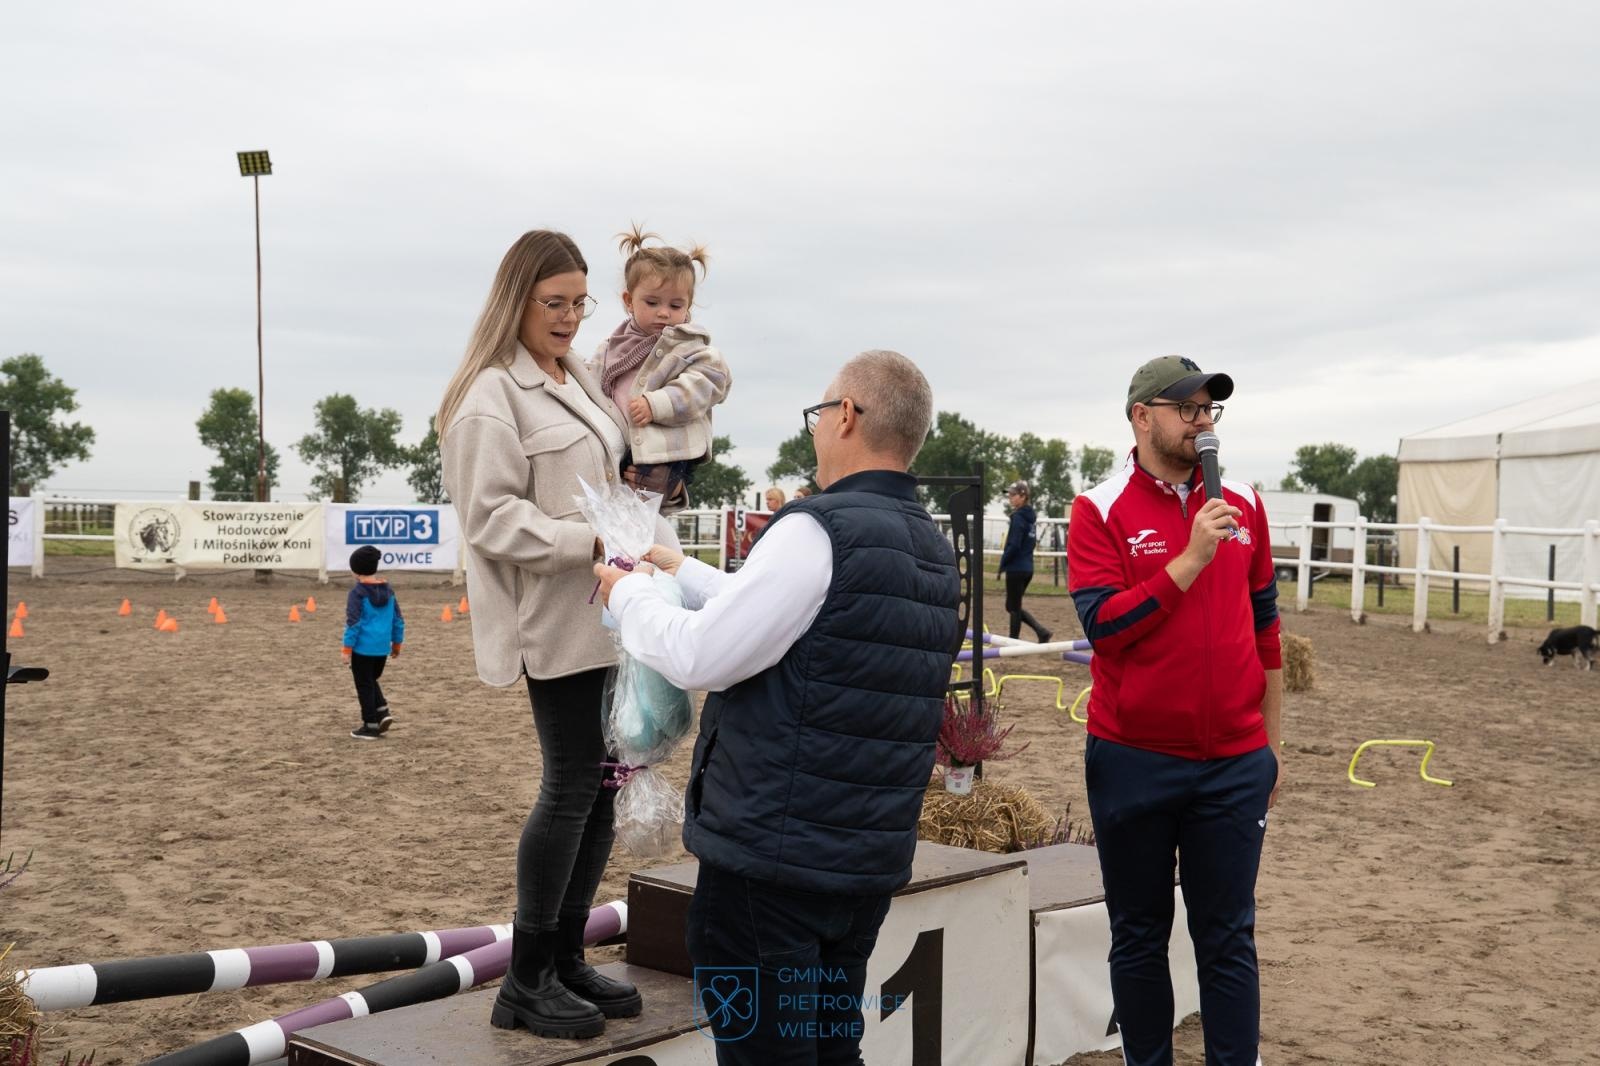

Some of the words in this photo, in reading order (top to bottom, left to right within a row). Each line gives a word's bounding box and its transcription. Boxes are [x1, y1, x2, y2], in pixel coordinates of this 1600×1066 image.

[202, 510, 304, 524] Stowarzyszenie
[737, 510, 744, 529] 5
[217, 525, 289, 536] Hodowców
[194, 539, 198, 550] i
[202, 539, 279, 550] Miłośników
[283, 538, 312, 550] Koni
[223, 553, 283, 564] Podkowa
[383, 552, 433, 564] OWICE
[880, 927, 944, 1066] 1
